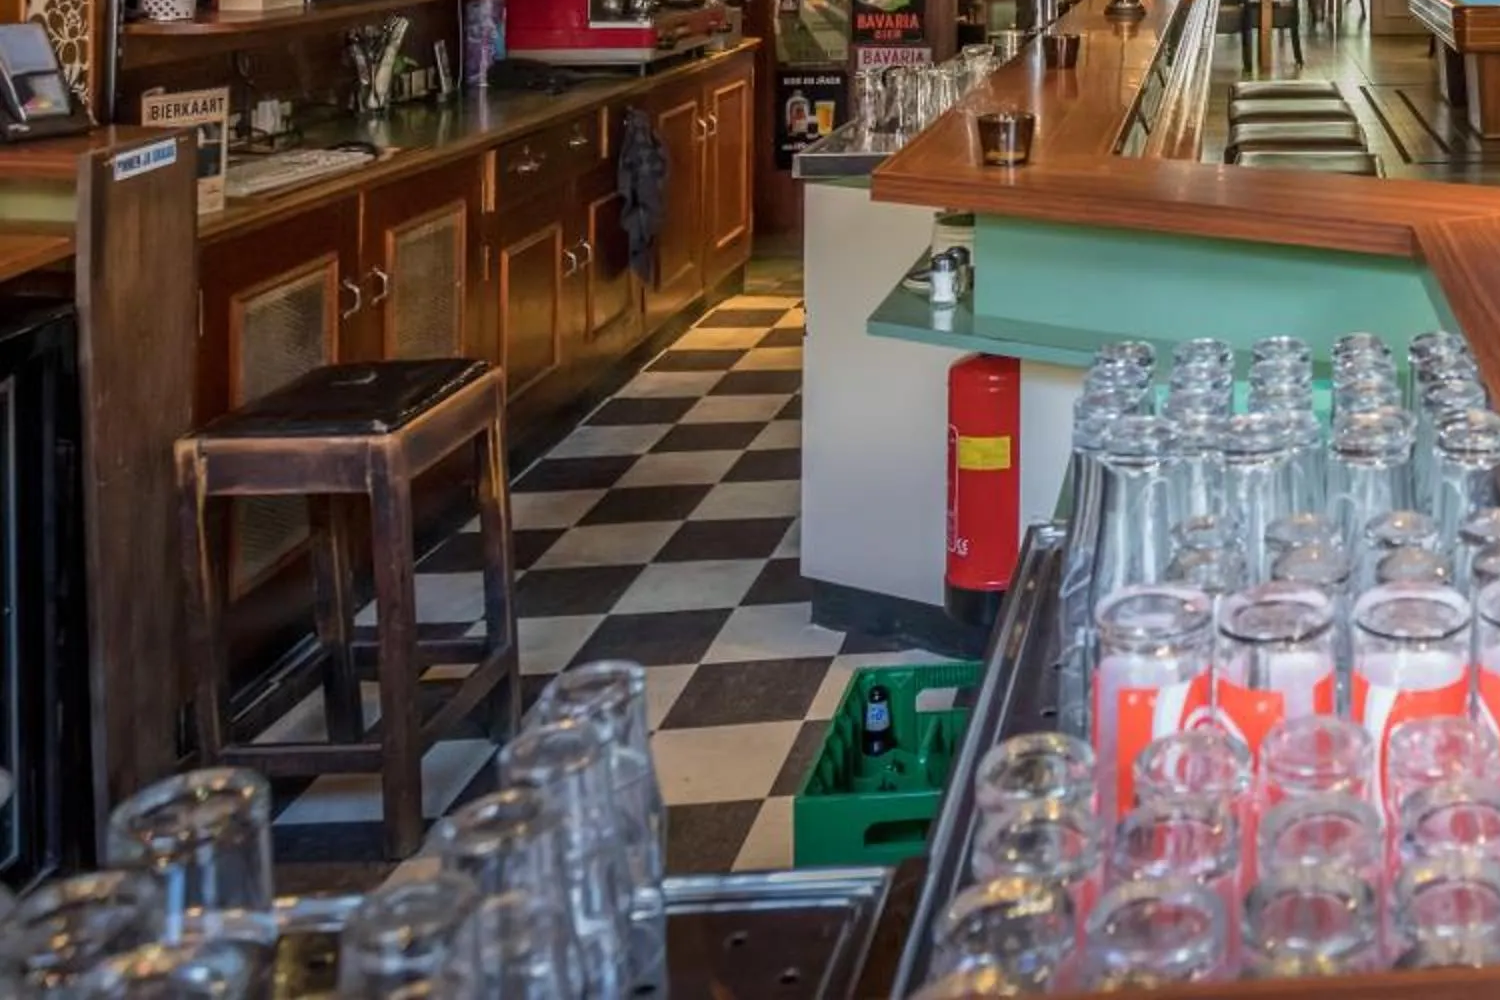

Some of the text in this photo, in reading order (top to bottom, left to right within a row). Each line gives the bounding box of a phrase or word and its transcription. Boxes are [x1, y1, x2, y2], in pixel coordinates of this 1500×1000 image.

[857, 12, 920, 30] BAVARIA
[863, 49, 925, 65] BAVARIA
[151, 97, 225, 121] BIERKAART
